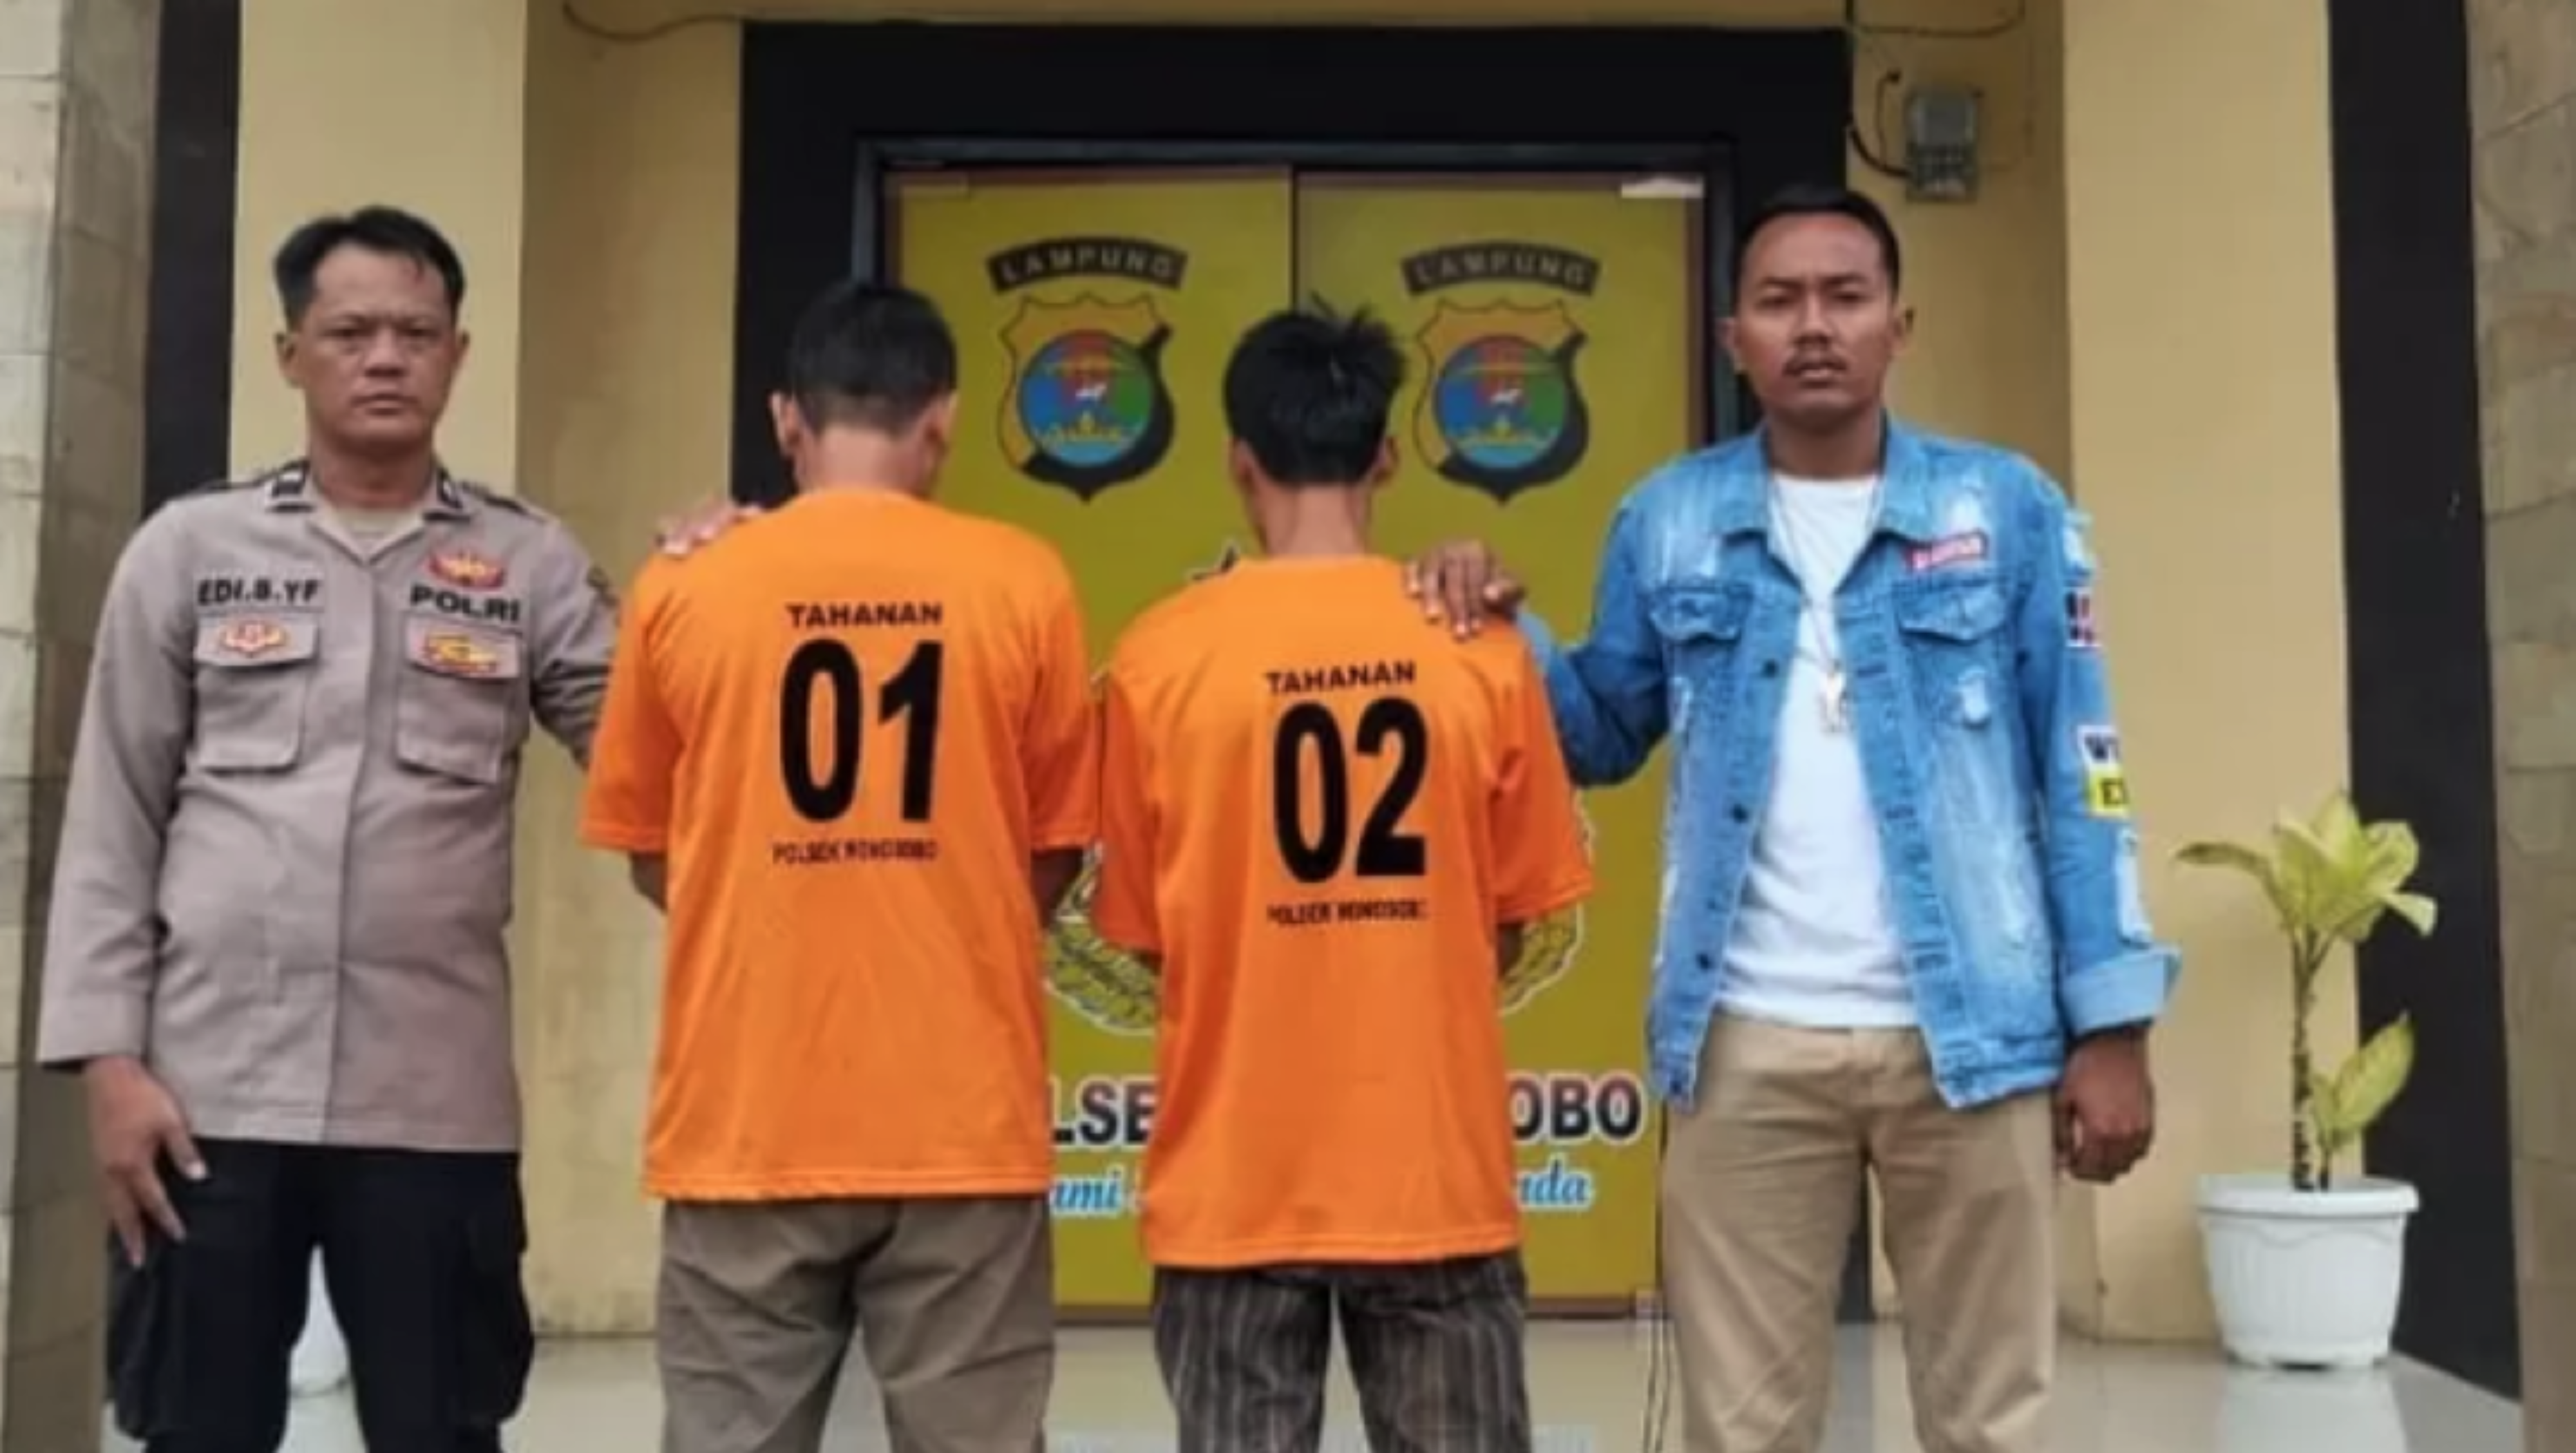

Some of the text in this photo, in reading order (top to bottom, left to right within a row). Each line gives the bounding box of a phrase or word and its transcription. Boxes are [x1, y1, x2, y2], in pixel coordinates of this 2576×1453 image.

[999, 243, 1172, 283] LAMPUNG
[1414, 249, 1587, 286] LAMPUNG
[410, 583, 521, 622] POLRI
[786, 602, 943, 627] TAHANAN
[1265, 661, 1415, 693] TAHANAN
[780, 638, 943, 822] 01
[1274, 696, 1426, 883] 02
